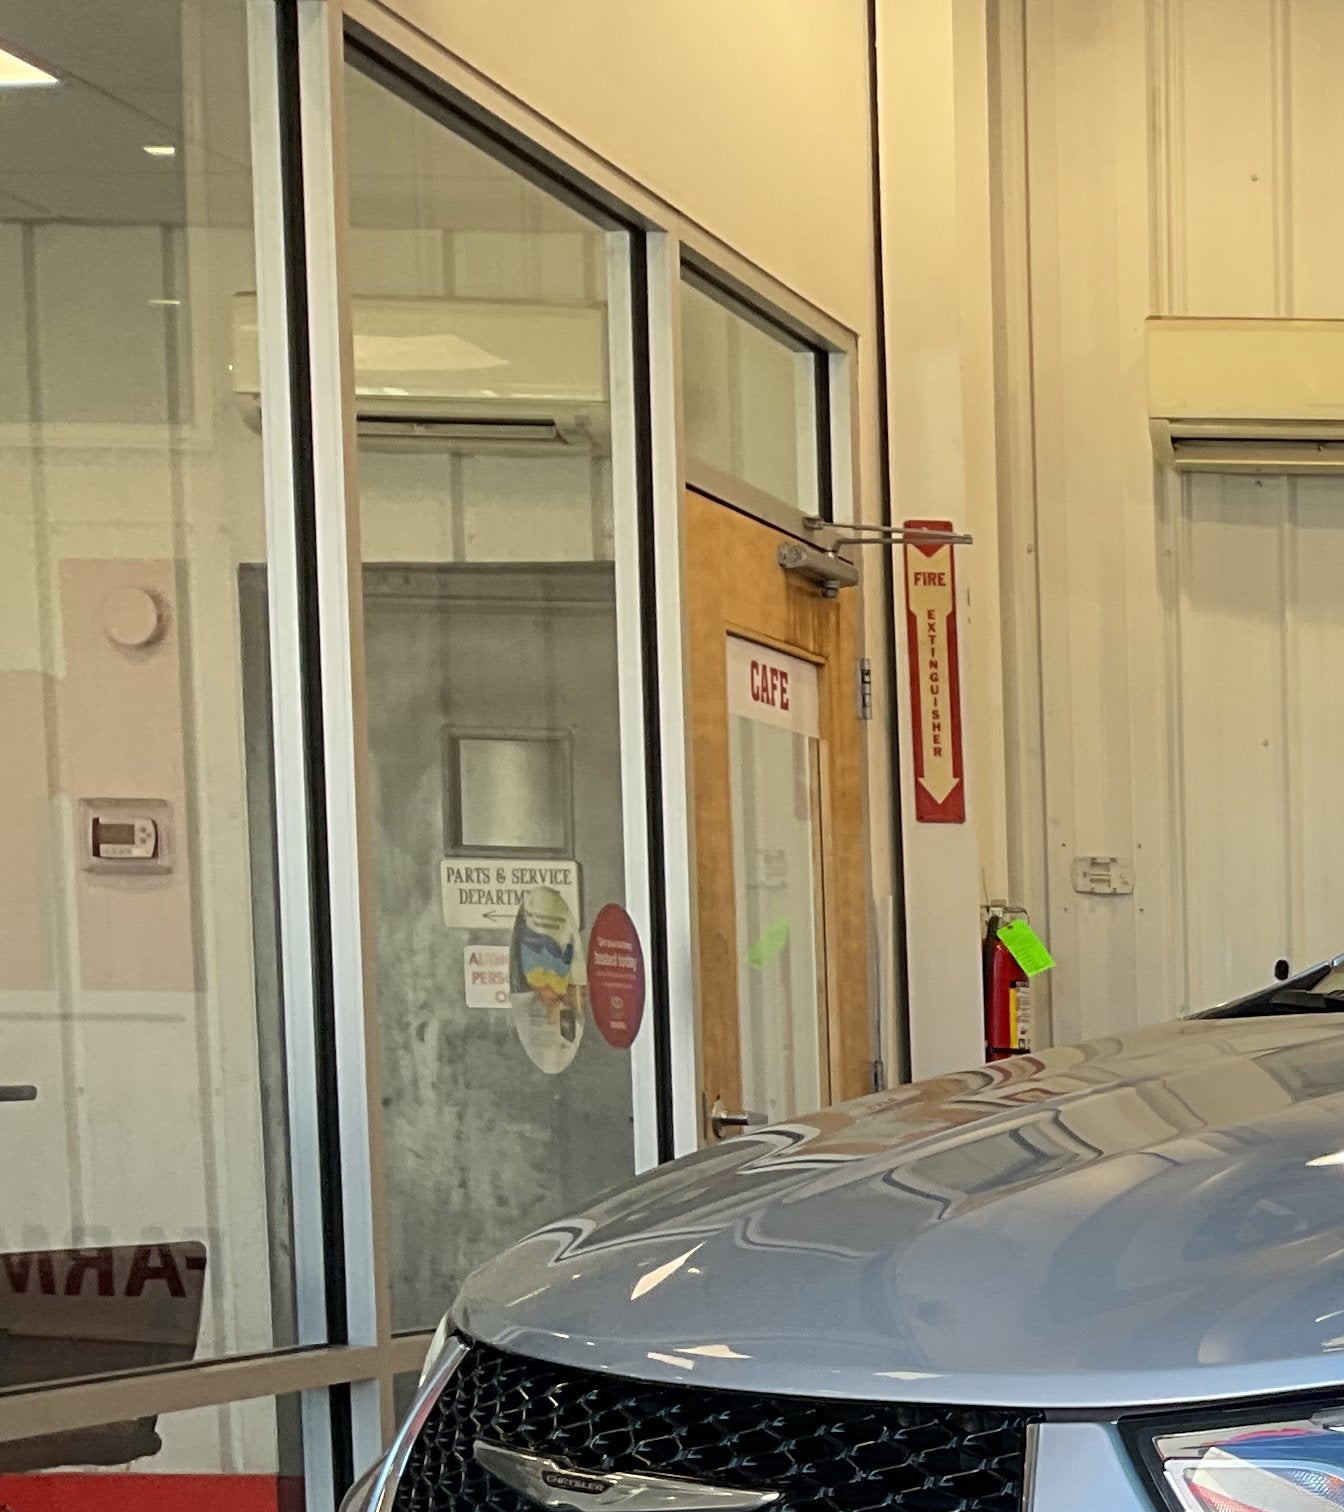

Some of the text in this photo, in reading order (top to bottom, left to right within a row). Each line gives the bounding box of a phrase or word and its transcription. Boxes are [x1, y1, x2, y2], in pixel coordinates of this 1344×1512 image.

[913, 571, 947, 587] FIRE
[750, 660, 789, 711] CAFE
[927, 608, 943, 758] EXTINGUISHER
[446, 866, 572, 886] PARTS & SERVICE
[459, 888, 533, 905] DEPARTM
